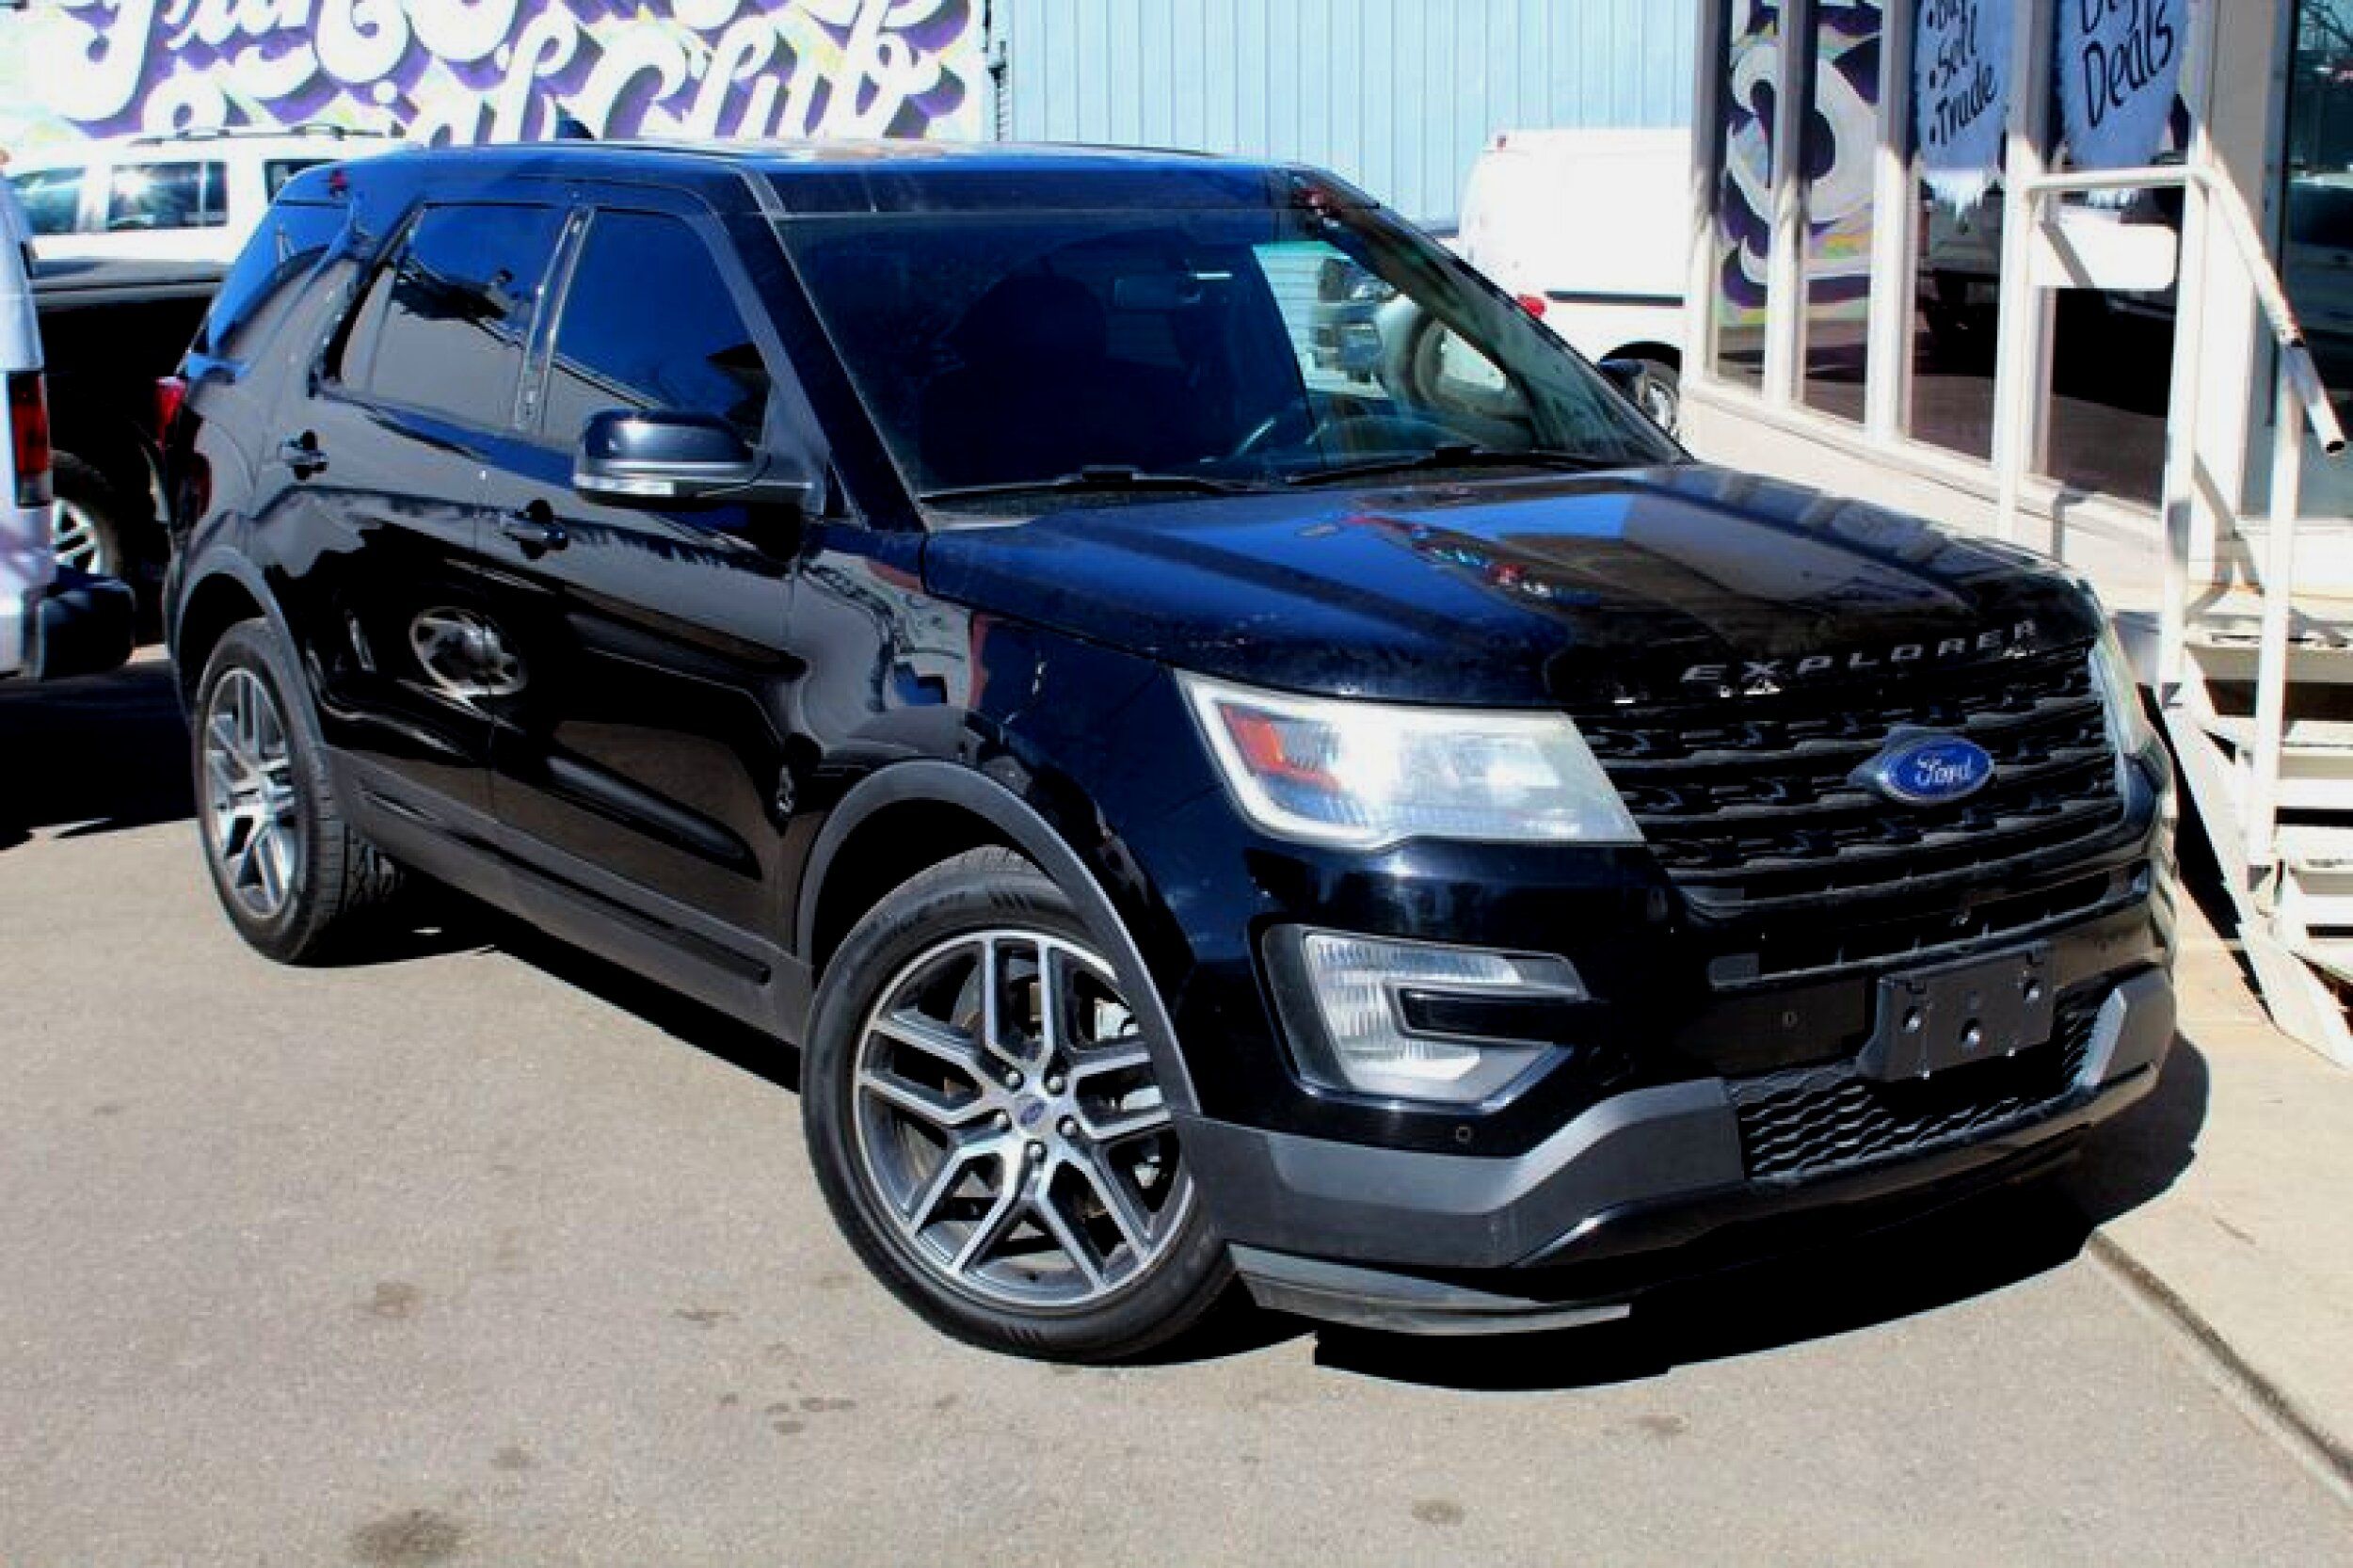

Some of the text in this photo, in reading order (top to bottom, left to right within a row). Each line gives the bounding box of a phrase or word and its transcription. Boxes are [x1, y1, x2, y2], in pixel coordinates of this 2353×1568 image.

[1937, 3, 1977, 88] Sell
[2082, 0, 2175, 129] Deals
[1935, 59, 1997, 145] Trade
[1680, 619, 2037, 683] EXPLORER
[1914, 754, 1973, 787] Ford
